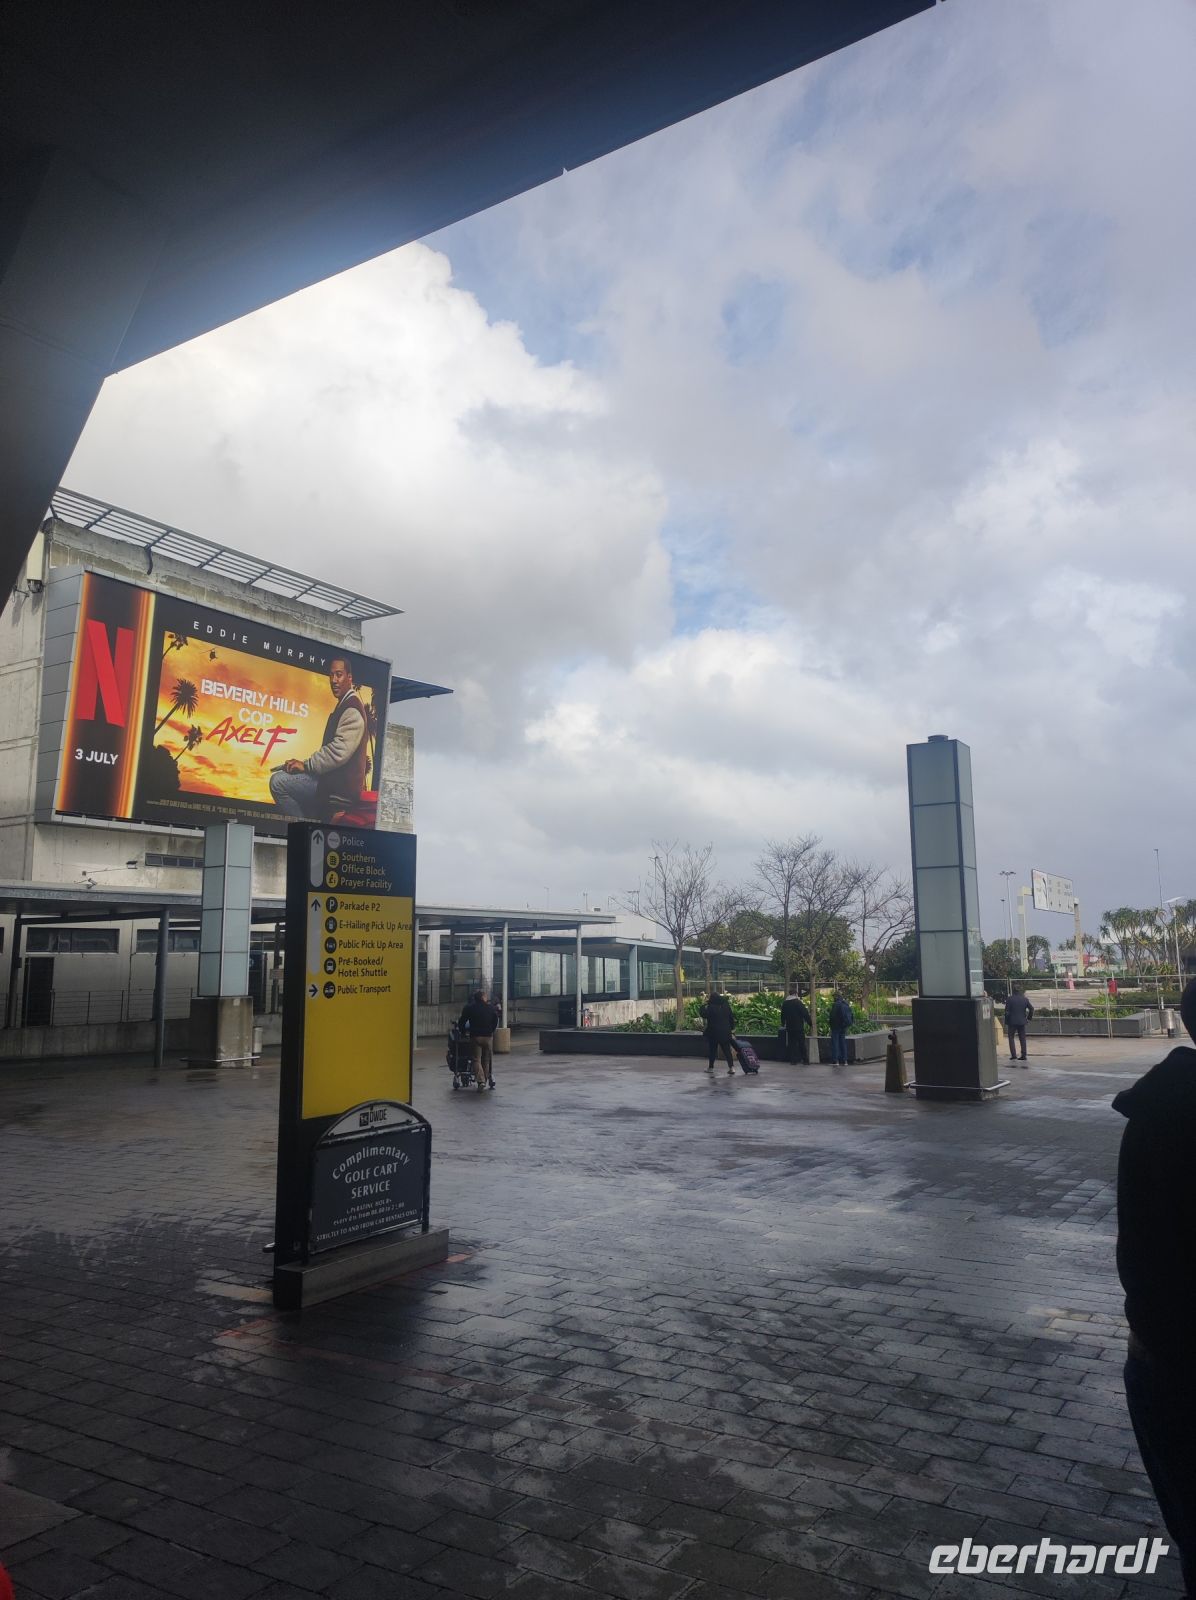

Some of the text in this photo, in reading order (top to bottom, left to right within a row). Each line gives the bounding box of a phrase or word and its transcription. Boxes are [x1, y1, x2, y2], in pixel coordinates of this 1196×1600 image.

[193, 621, 326, 666] EDDIE MURPHY
[76, 619, 134, 728] N
[201, 679, 309, 717] BEVERLY HILLS
[239, 707, 273, 725] COP
[206, 717, 297, 766] AXEL F
[75, 748, 118, 765] 3 JULY
[342, 836, 364, 847] Police
[342, 853, 376, 863] Southern
[342, 864, 385, 876] Office Block
[341, 879, 392, 891] Prayer Facility
[340, 902, 380, 911] Parkade P2
[339, 920, 412, 932] E-Hailing Pick Up Area
[339, 940, 403, 950] Public Pick Up Area
[339, 957, 383, 965] Pre-Booked/
[338, 967, 387, 978] Hotel Shuttle
[338, 984, 390, 995] Public Transport
[332, 1147, 410, 1179] Complimentary
[345, 1162, 398, 1184] GOLF CART
[351, 1180, 390, 1198] SERVICE
